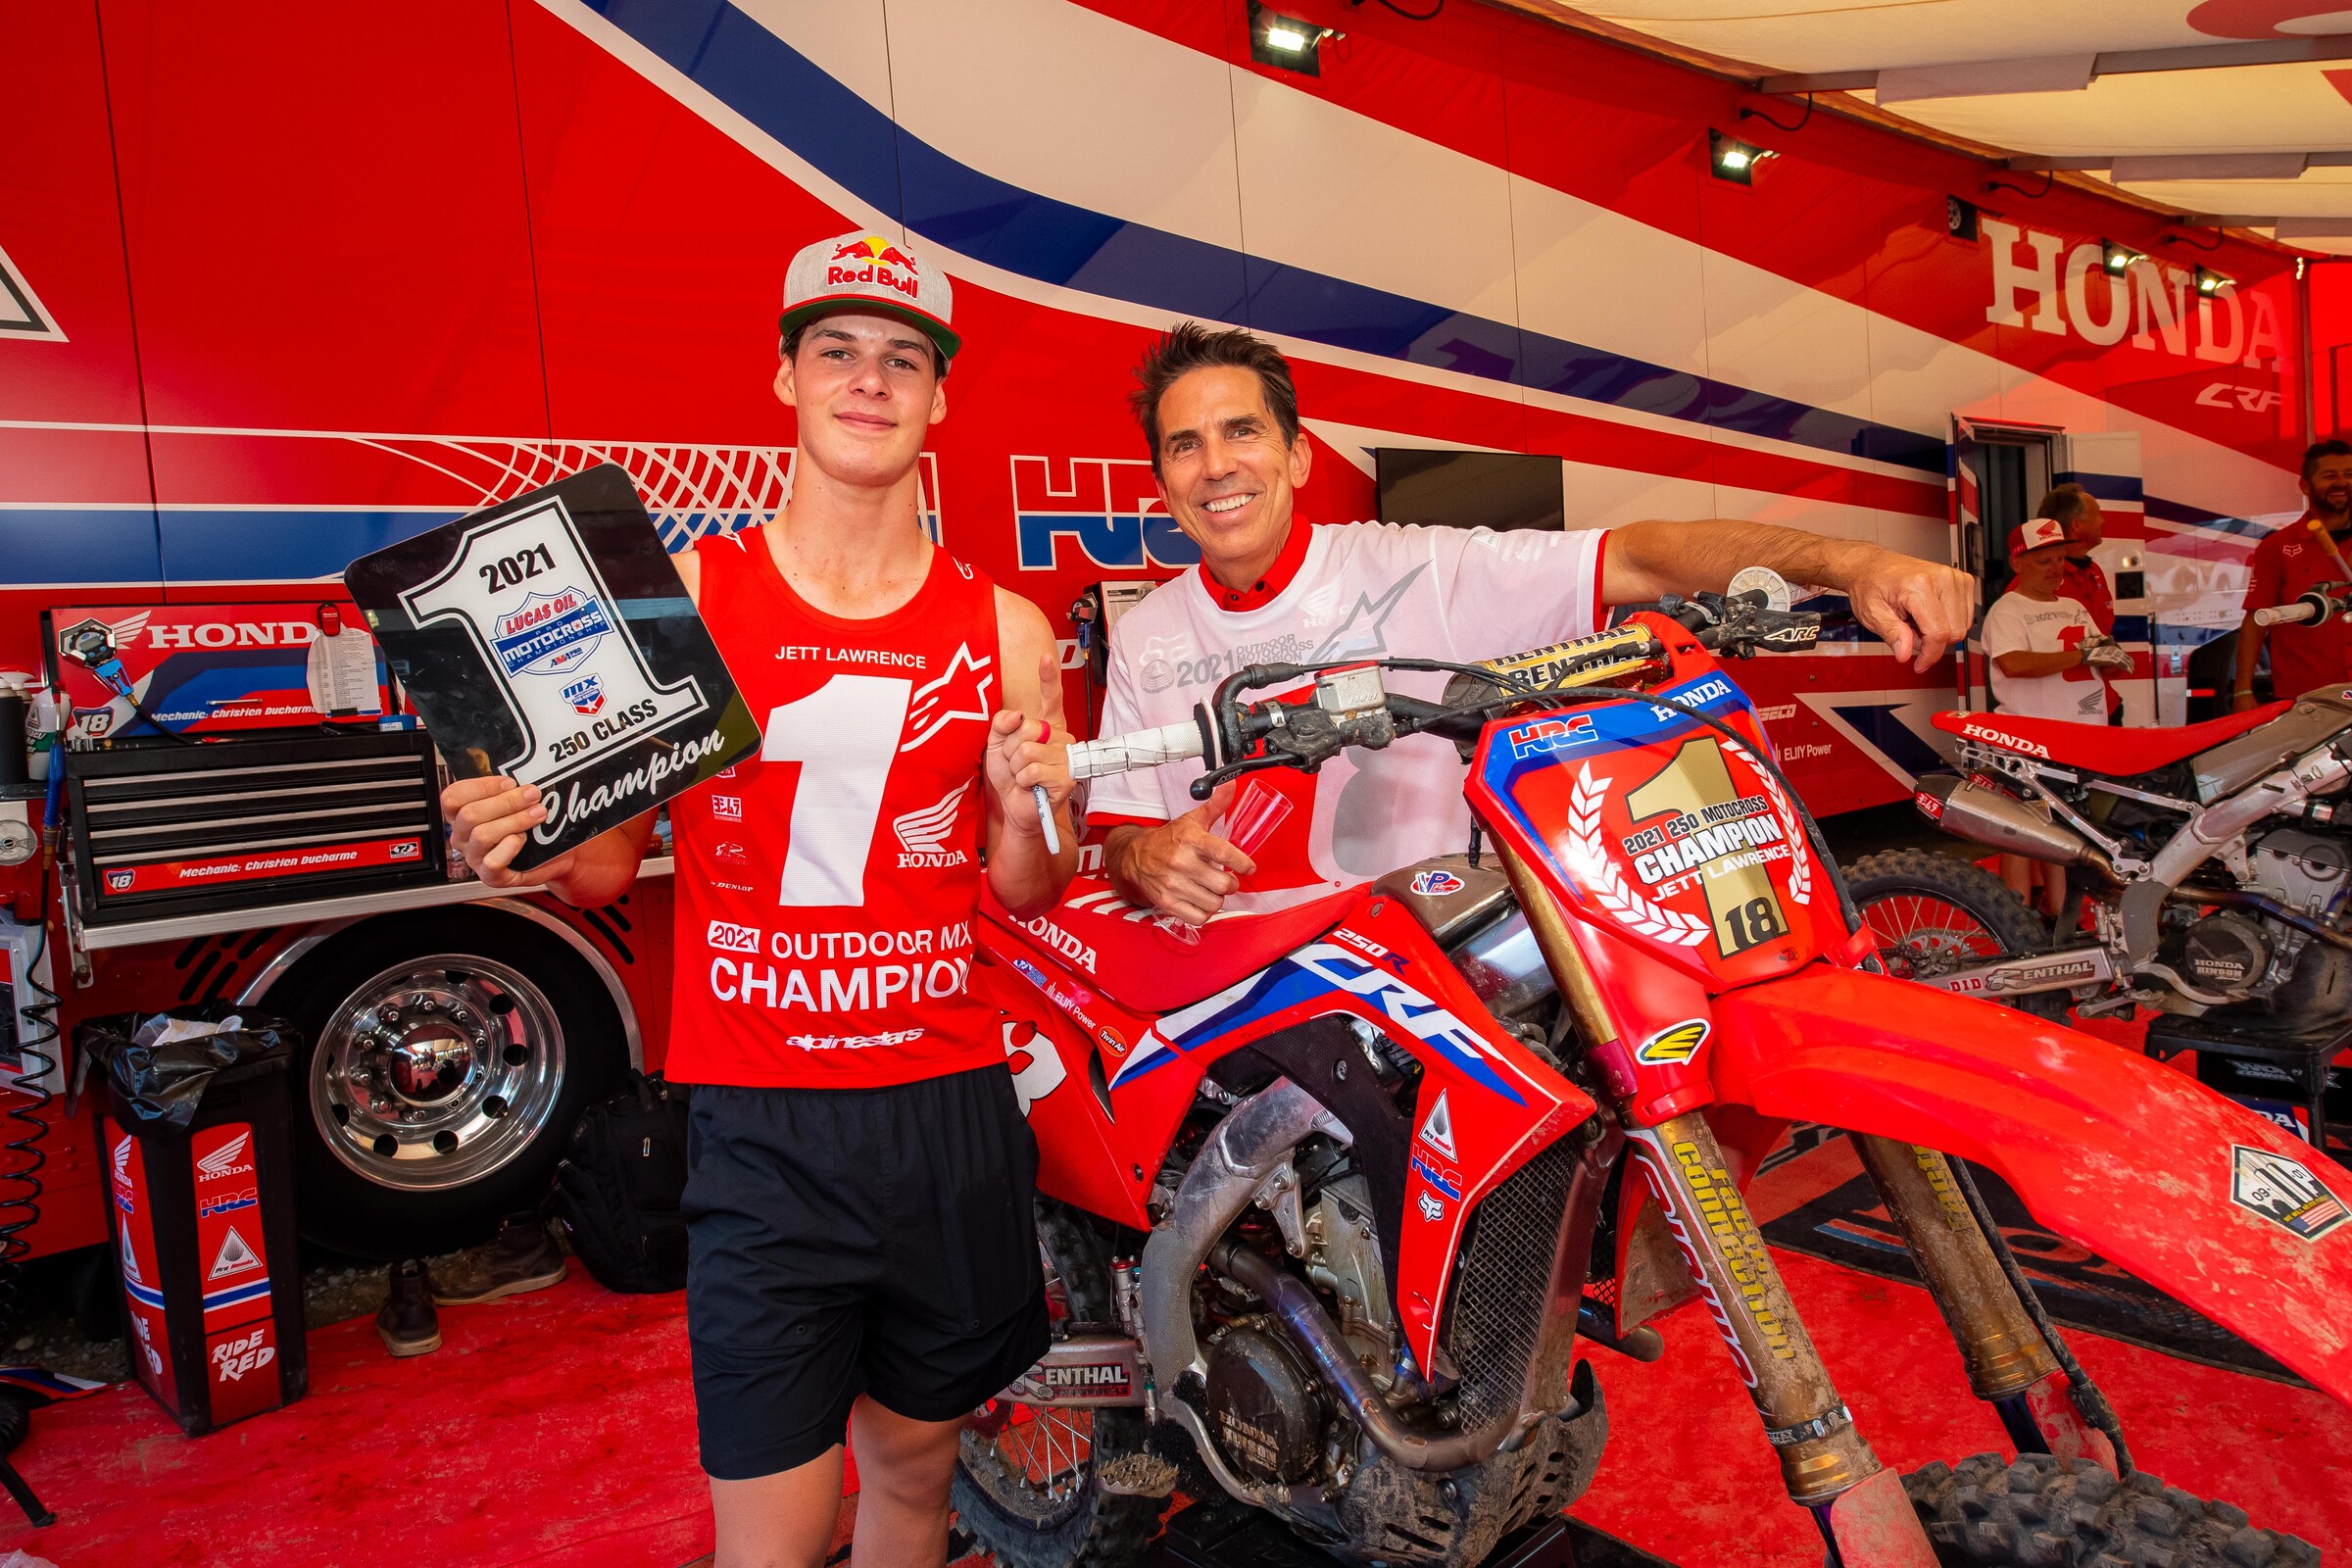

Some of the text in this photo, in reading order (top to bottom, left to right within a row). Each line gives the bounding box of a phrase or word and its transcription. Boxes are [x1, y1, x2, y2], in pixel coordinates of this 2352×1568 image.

[828, 265, 918, 298] Red Bull
[1982, 218, 2286, 373] HONDA
[2195, 383, 2283, 413] CRF
[479, 543, 557, 594] 2021
[506, 594, 576, 635] LUCAS OIL
[535, 620, 563, 636] PRO
[147, 622, 318, 648] HOND
[502, 611, 603, 662] MOTOCROSS
[509, 620, 606, 667] CHAMPIONSHIP
[1237, 641, 1314, 662] MOTOCROSS
[1764, 626, 1820, 642] ARC
[775, 646, 926, 669] JETT LAWRENCE
[1177, 634, 1295, 688] 2021 OUTDOOR
[78, 714, 109, 733] 18
[212, 706, 262, 718] Christien
[1509, 679, 1732, 760] HRC HONDA
[549, 699, 658, 762] 250 CLASS
[1963, 723, 2050, 760] HONDA
[1806, 744, 1833, 759] Power
[533, 729, 724, 845] Champion
[760, 673, 912, 906] 1
[1623, 796, 1768, 857] 2021 250 MOTOCROSS
[179, 850, 358, 879] Mechanic: Christien Ducharme
[897, 850, 967, 868] HONDA
[1634, 813, 1784, 885] CHAMPION
[111, 874, 131, 889] 18
[717, 881, 754, 893] DUNLOP
[1652, 844, 1791, 902] JETT LAWRENCE
[711, 920, 972, 959] 2021 OUTDOOR MX
[1725, 897, 1781, 952] 18
[1009, 915, 1097, 974] ONDA
[1333, 928, 1410, 976] 250R
[2194, 959, 2245, 970] HONDA
[710, 955, 972, 1012] CHAMPION
[1073, 1006, 1096, 1029] Power
[1288, 944, 1504, 1061] CRF
[786, 1028, 924, 1052] alpinestars
[1101, 1030, 1126, 1054] Twin Air
[115, 1169, 133, 1189] HONDA
[199, 1164, 254, 1182] HONDA
[1411, 1143, 1462, 1201] HRC
[200, 1187, 258, 1218] HRC
[212, 1329, 265, 1364] RIDE
[219, 1347, 275, 1382] RED
